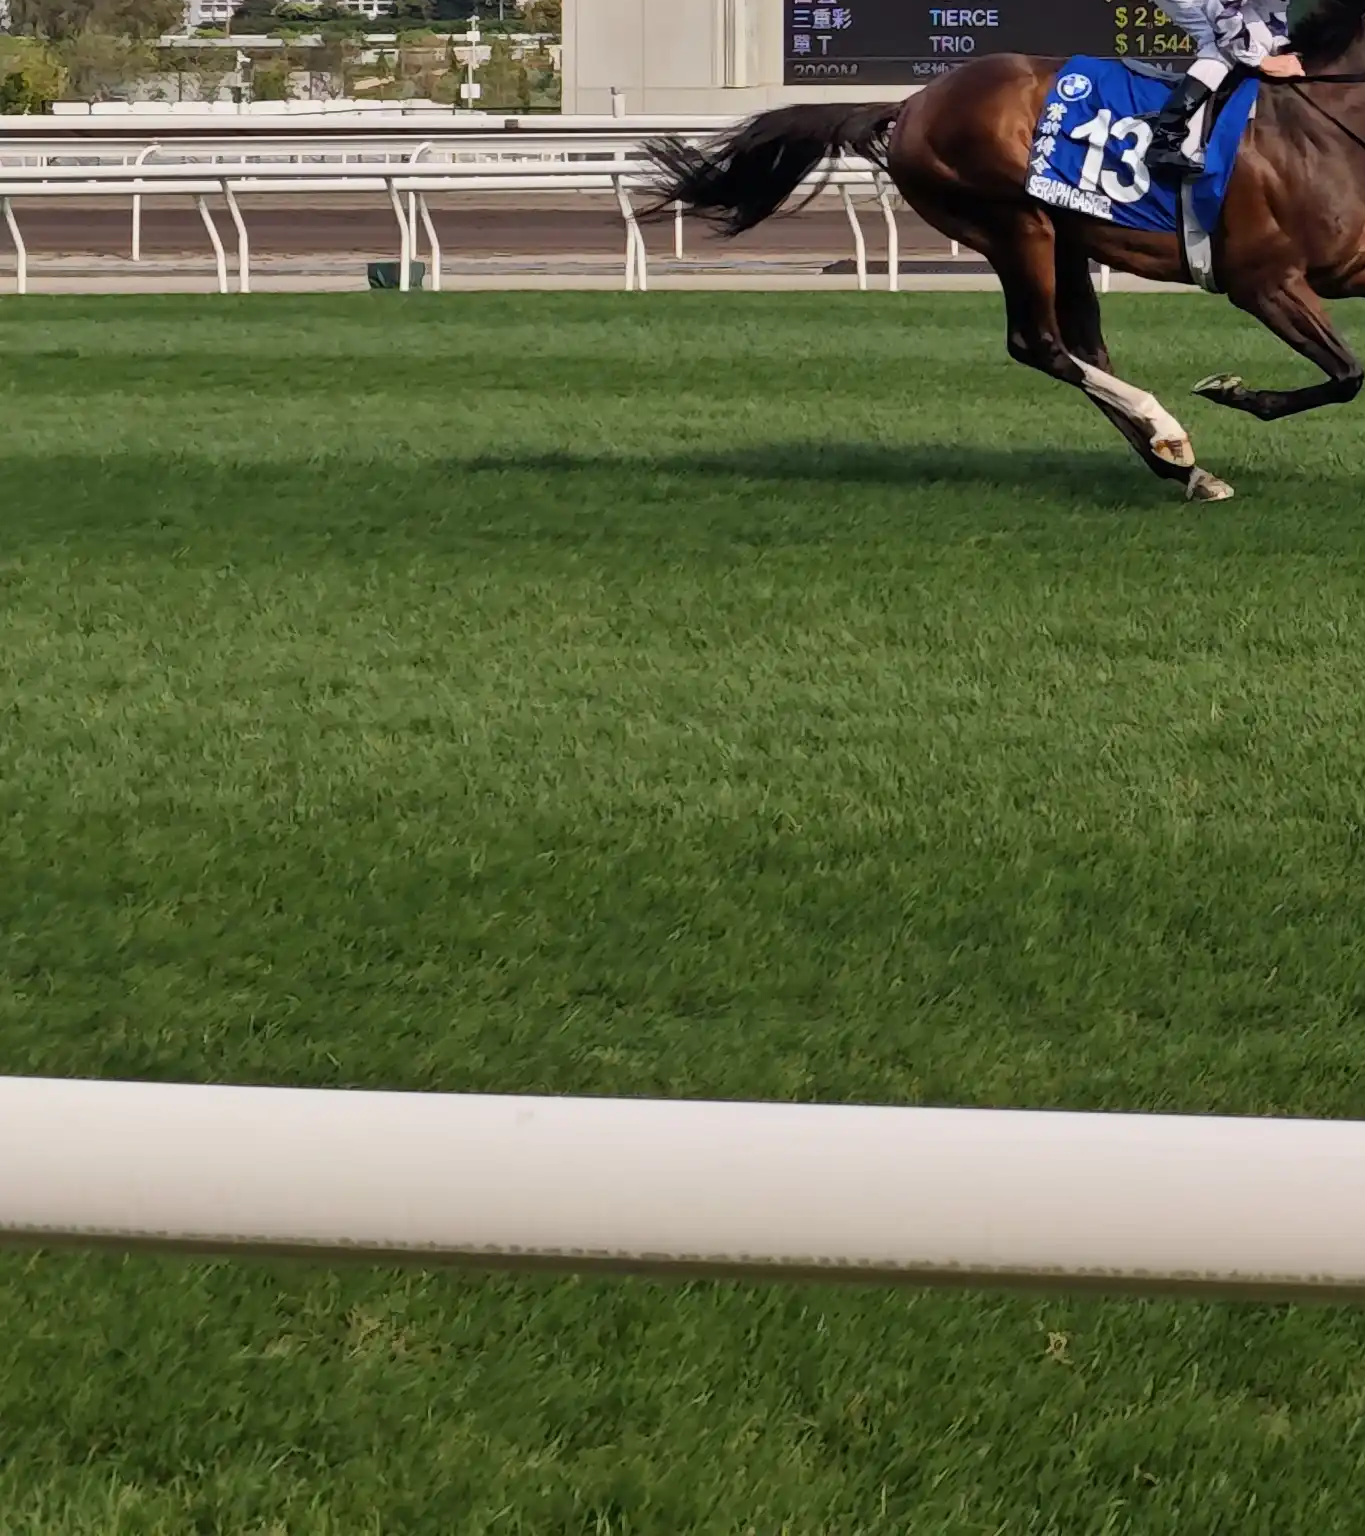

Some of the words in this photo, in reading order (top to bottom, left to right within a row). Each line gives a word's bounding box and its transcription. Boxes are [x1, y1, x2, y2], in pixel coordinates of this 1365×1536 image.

[792, 8, 852, 29] 三重彩
[930, 10, 998, 26] TIERCE
[1115, 7, 1128, 29] $
[929, 36, 974, 52] TRIO
[1115, 33, 1128, 55] $
[1070, 109, 1153, 203] 13
